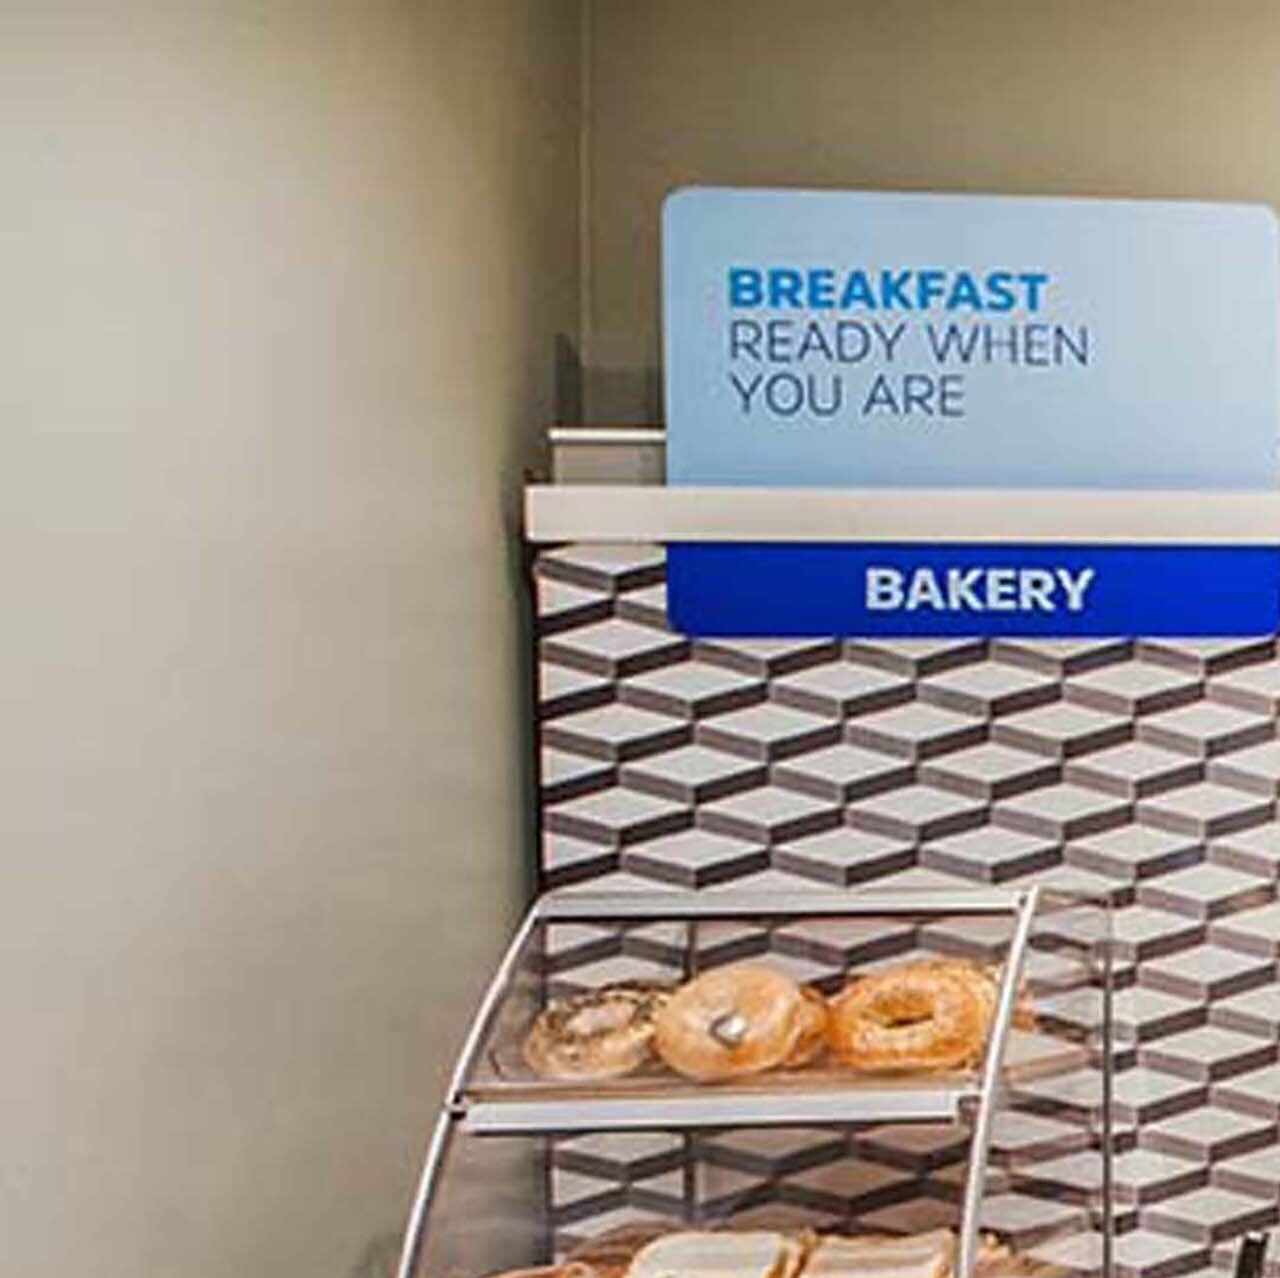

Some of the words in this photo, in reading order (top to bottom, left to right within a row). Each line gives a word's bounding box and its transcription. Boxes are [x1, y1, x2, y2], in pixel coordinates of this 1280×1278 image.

[728, 268, 1048, 311] BREAKFAST
[728, 320, 904, 364] READY
[928, 325, 1090, 366] WHEN
[730, 374, 842, 418] YOU
[862, 376, 966, 418] ARE
[864, 567, 1095, 612] BAKERY
